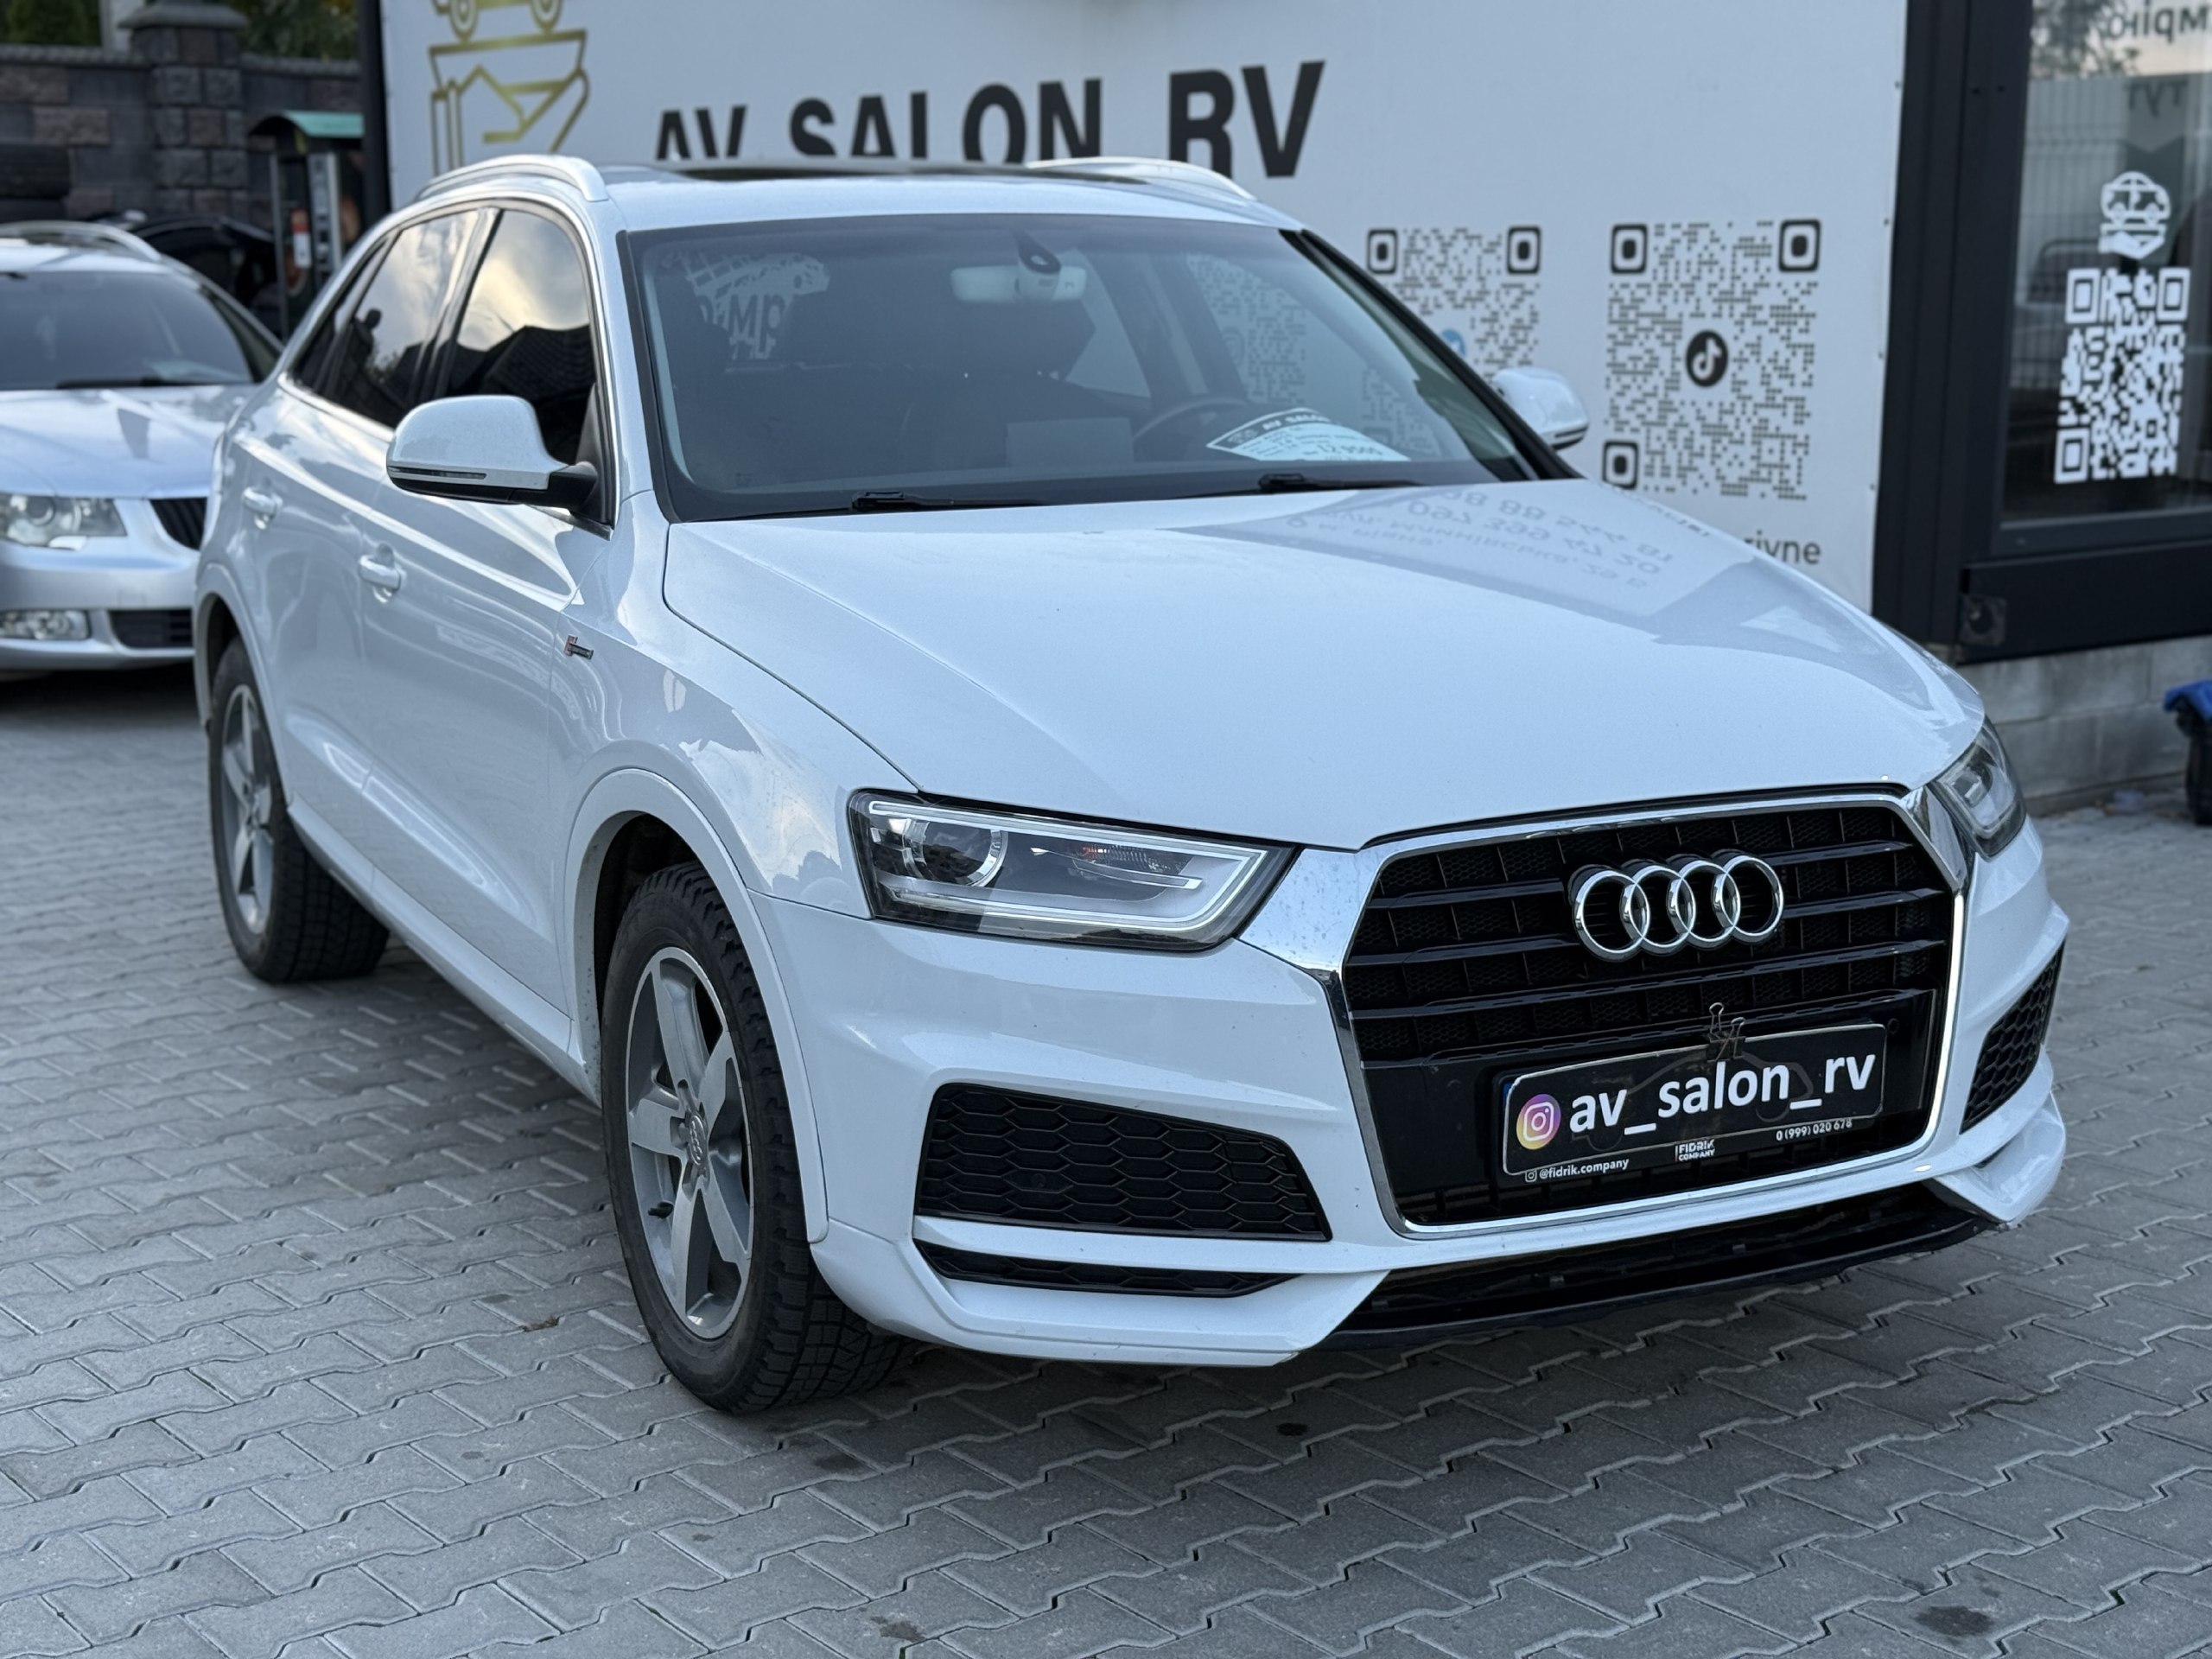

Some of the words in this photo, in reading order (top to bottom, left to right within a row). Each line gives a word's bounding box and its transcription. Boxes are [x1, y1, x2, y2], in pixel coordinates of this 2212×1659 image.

[657, 105, 747, 161] AV
[789, 78, 1103, 165] SALON
[1169, 60, 1325, 180] RV
[1569, 1053, 1876, 1136] av_salon_rv
[1784, 1125, 1811, 1141] (999)
[1813, 1122, 1832, 1135] 020
[1679, 1138, 1715, 1154] FIDRIK
[1679, 1148, 1715, 1162] COMPANY
[1539, 1159, 1630, 1179] @fidrik.company
